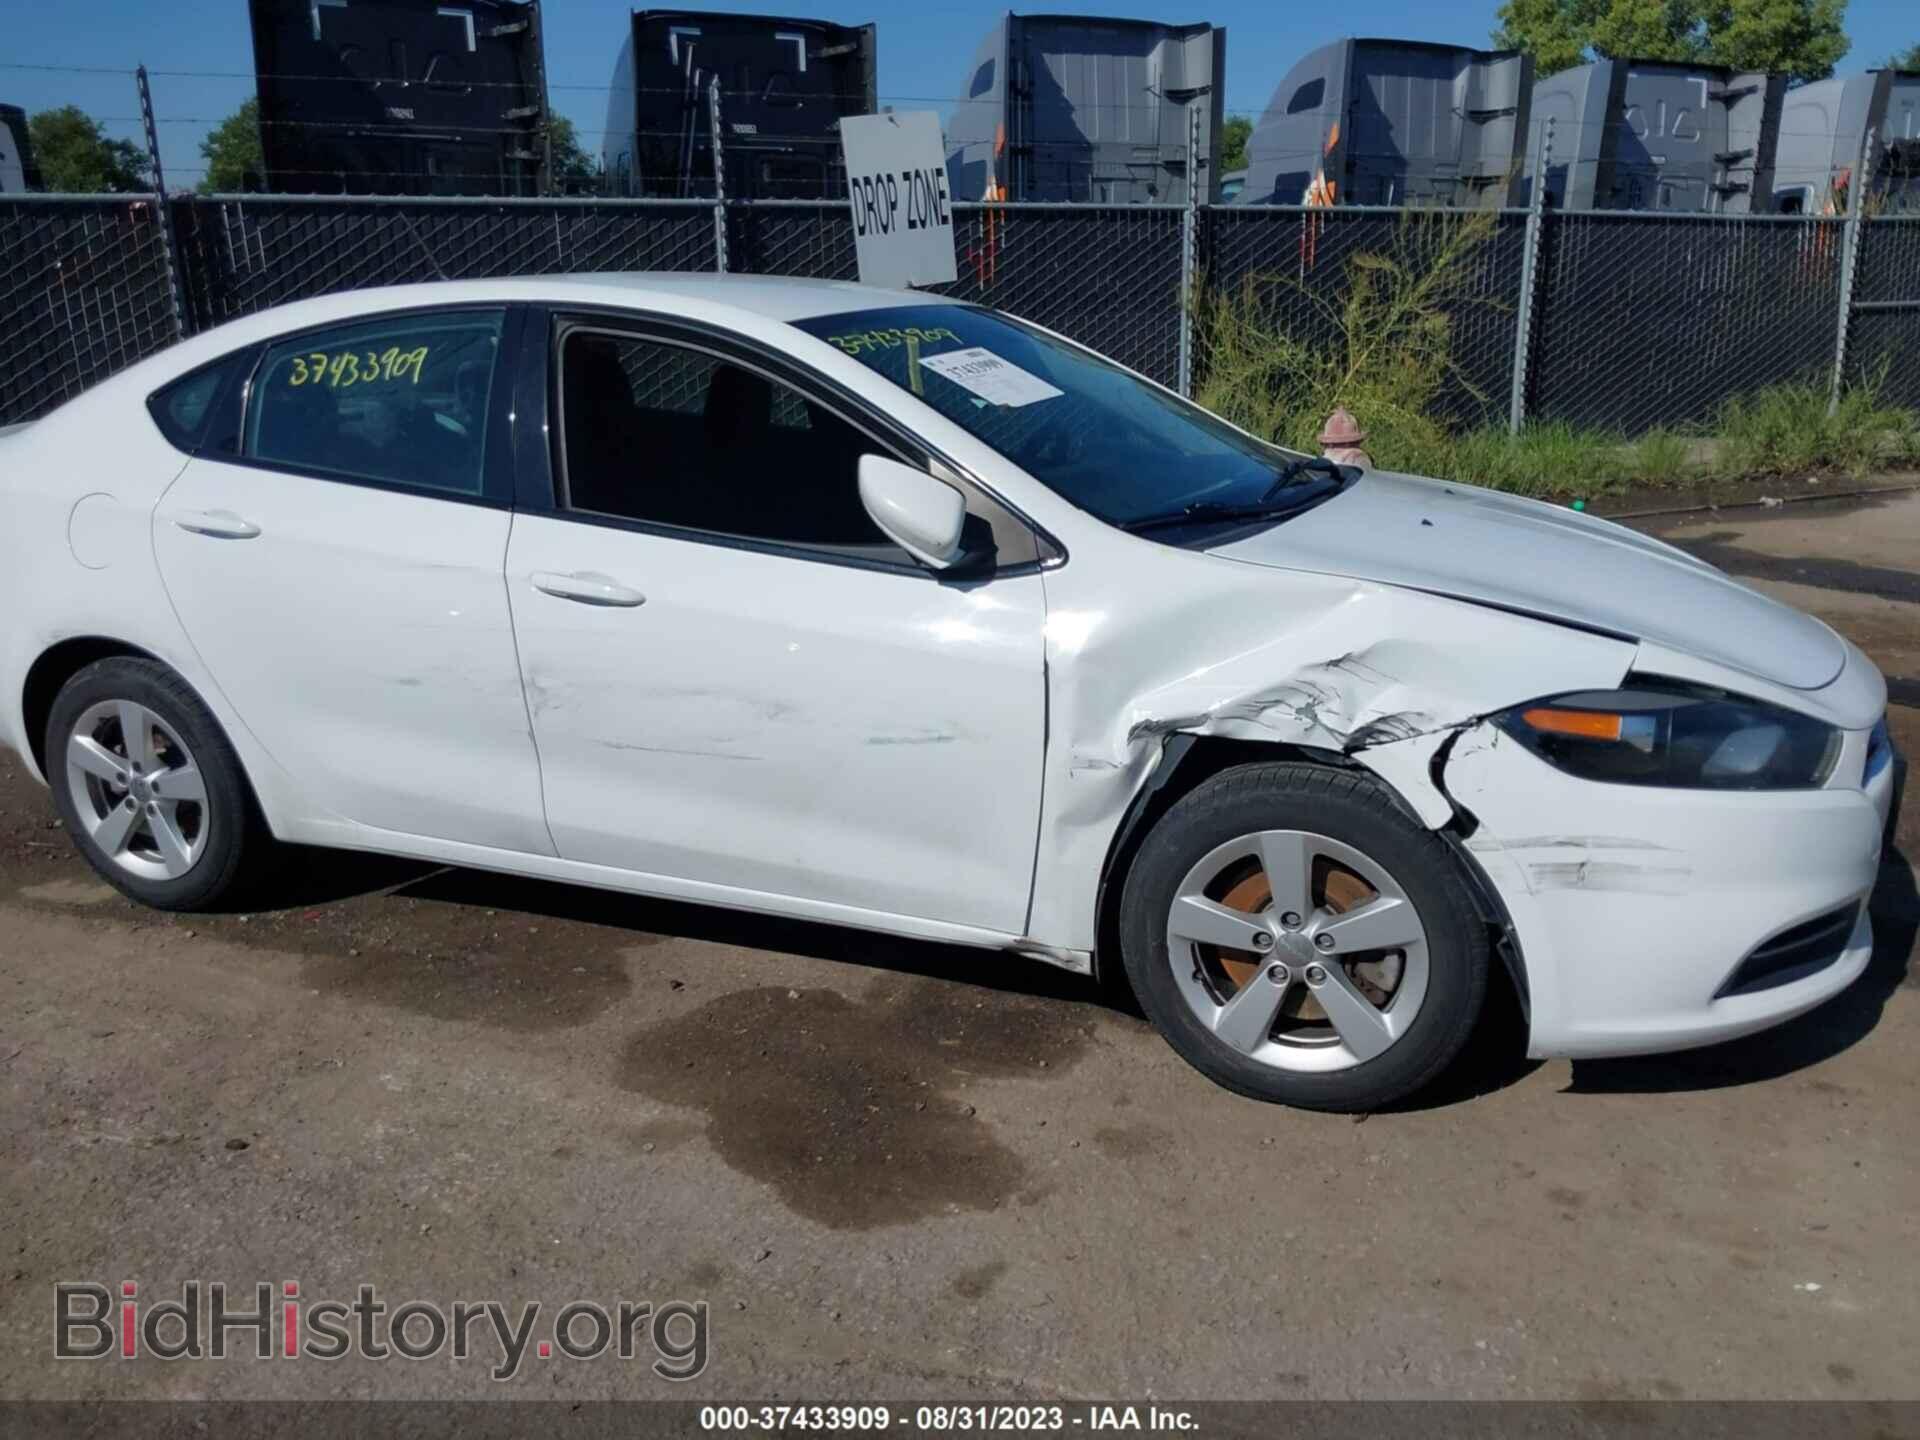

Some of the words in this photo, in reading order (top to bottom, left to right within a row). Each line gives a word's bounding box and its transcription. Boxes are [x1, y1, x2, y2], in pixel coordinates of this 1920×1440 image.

[851, 172, 898, 236] DROP
[902, 167, 949, 230] ZONE
[289, 346, 428, 387] 37433909
